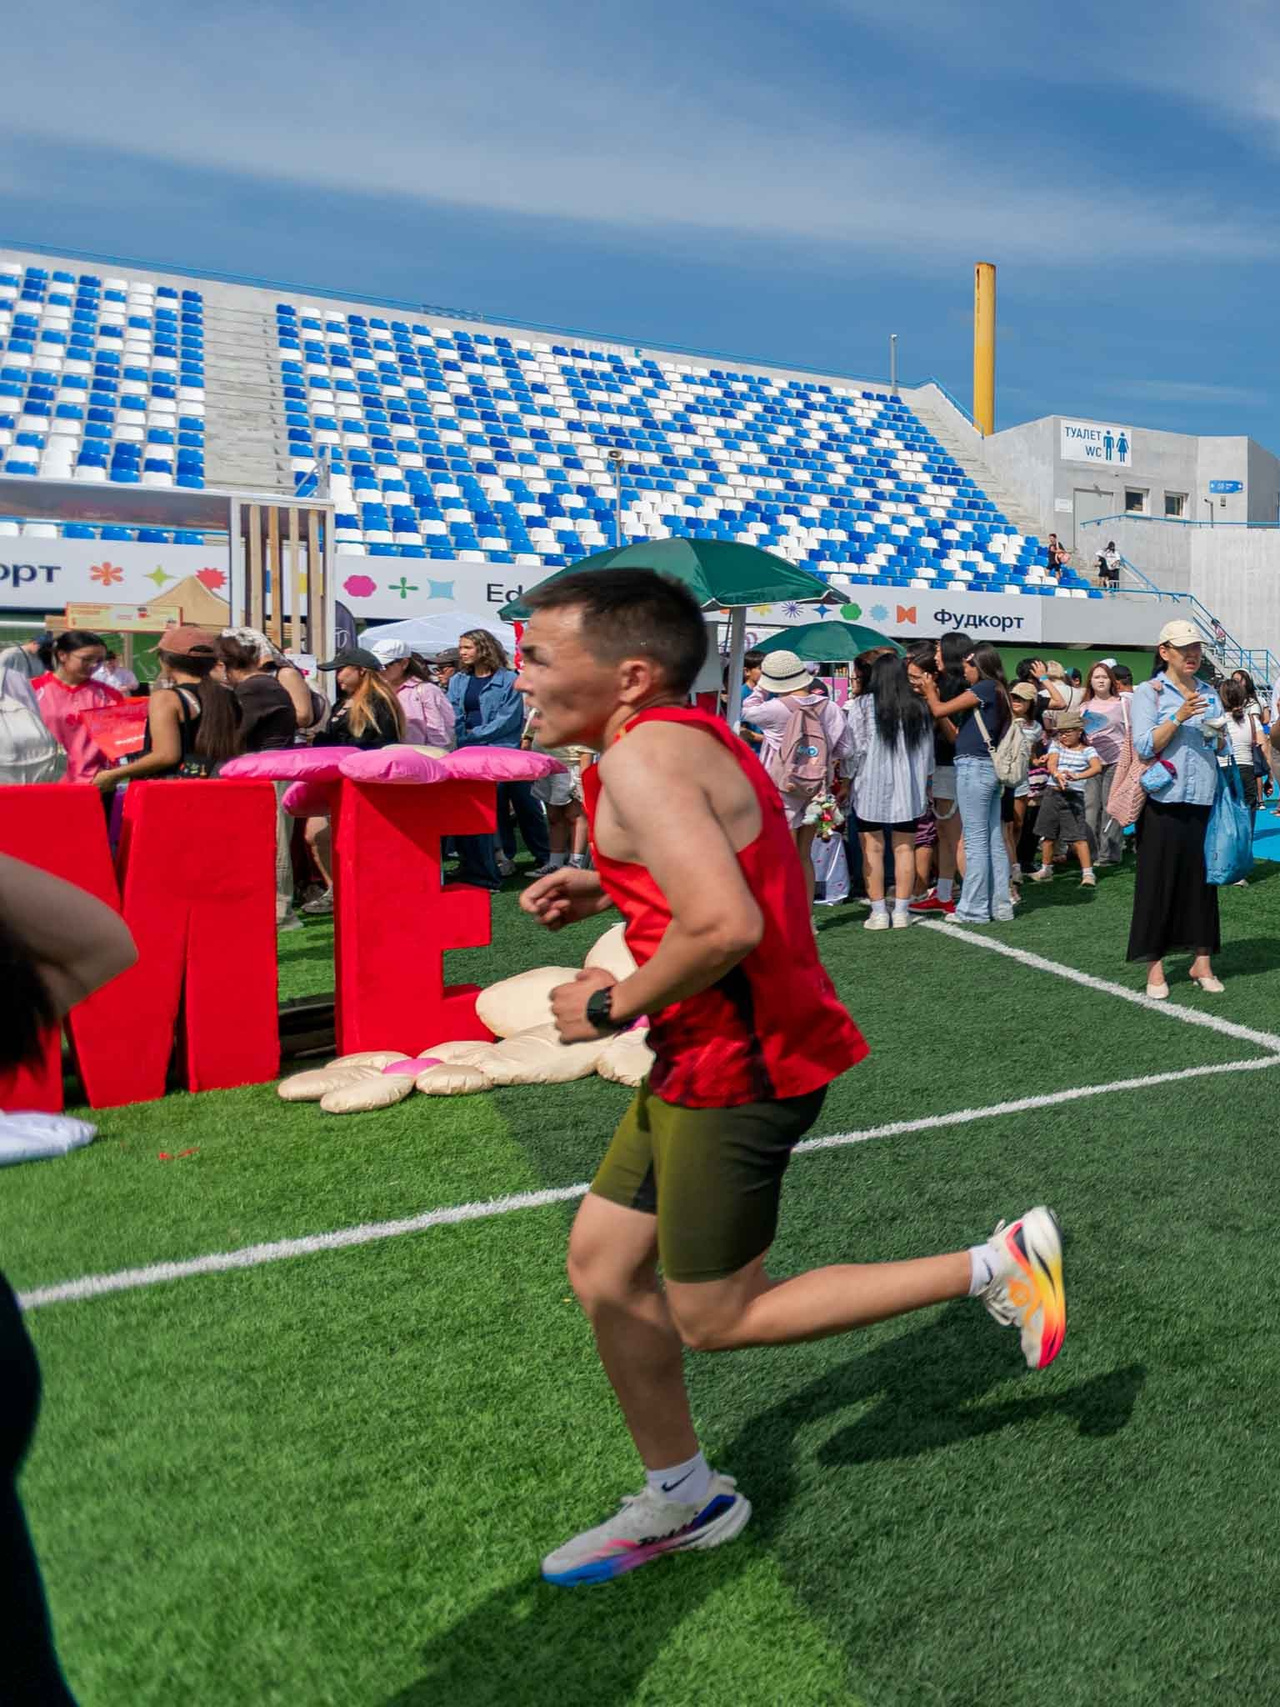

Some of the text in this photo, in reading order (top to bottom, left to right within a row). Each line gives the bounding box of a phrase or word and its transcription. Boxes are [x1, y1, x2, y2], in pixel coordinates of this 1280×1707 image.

[1065, 426, 1101, 441] ТУАЛЕТ
[1085, 445, 1102, 458] WC
[933, 608, 1024, 632] Фудкорт
